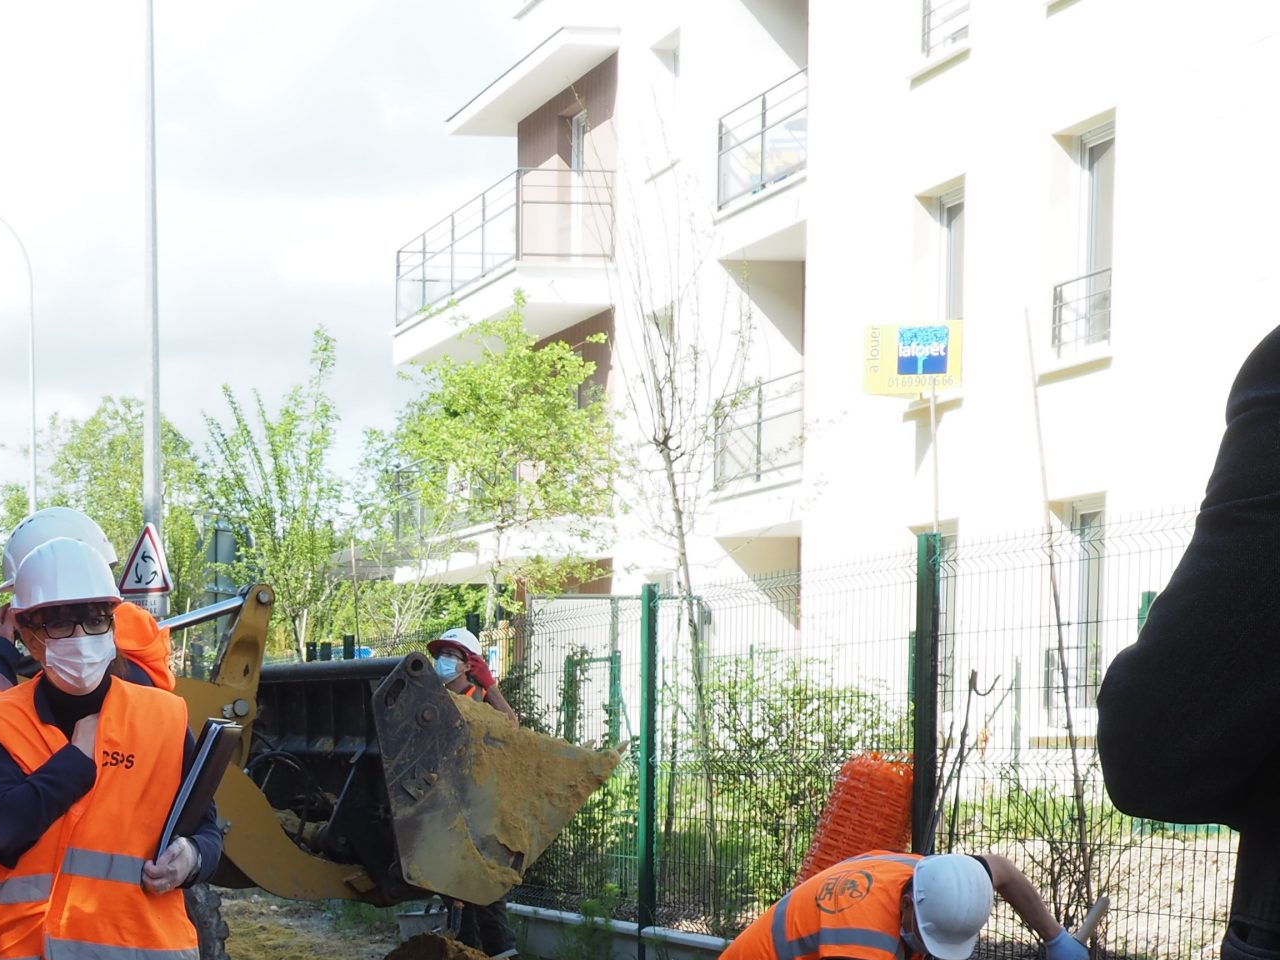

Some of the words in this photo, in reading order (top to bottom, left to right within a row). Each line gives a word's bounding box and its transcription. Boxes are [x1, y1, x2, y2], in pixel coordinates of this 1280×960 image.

[866, 325, 880, 361] louer
[888, 376, 899, 388] 01
[901, 376, 913, 388] 69
[915, 375, 927, 386] 90
[942, 375, 953, 385] 66
